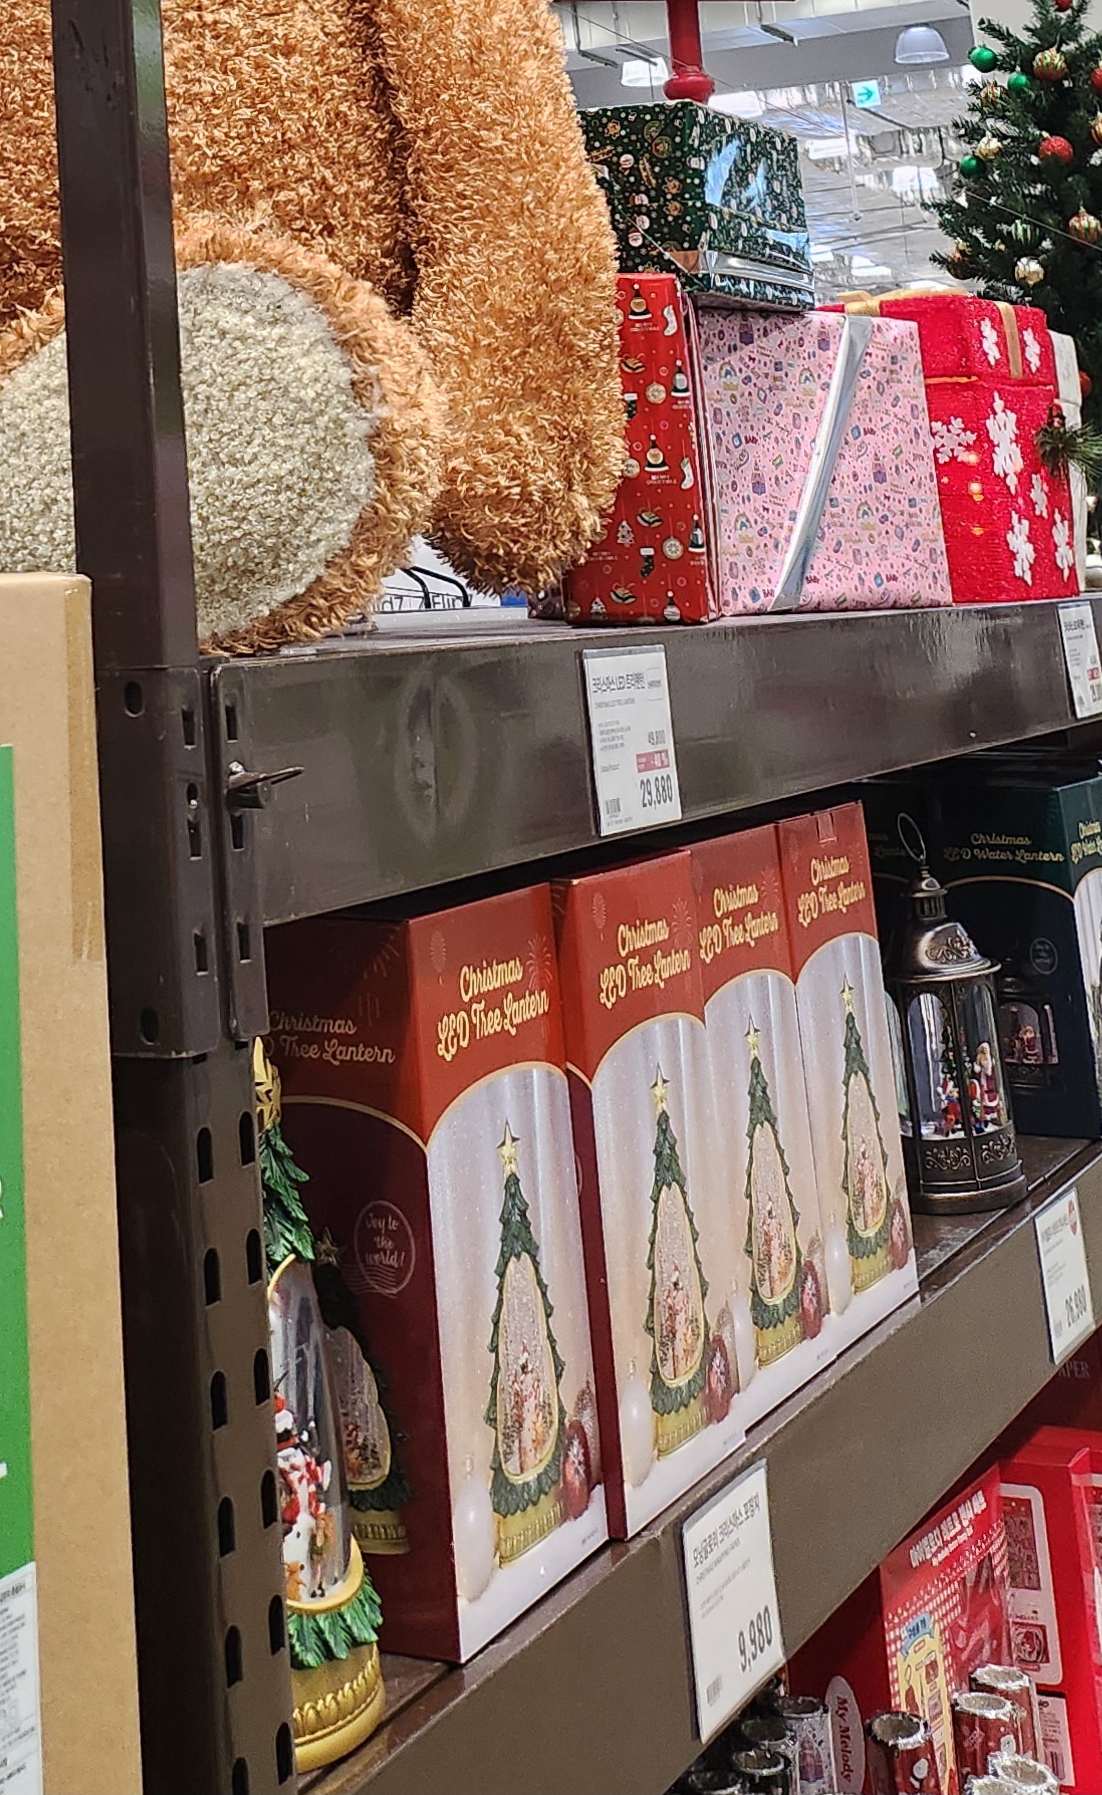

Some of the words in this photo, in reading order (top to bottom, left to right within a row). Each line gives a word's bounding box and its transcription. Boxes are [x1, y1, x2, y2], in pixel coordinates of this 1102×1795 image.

[639, 773, 674, 811] 29,880
[970, 832, 1033, 846] Christmas
[973, 848, 1014, 862] Water
[1014, 849, 1065, 864] Lantern
[809, 854, 851, 887] Christmas
[712, 882, 760, 919] Christmas
[616, 916, 671, 958] Christmas
[698, 922, 723, 965] LED
[722, 916, 747, 950] Tree
[745, 909, 780, 948] Lantern
[459, 955, 524, 1003] Christmas
[598, 961, 628, 1010] LED
[627, 952, 655, 992] Tree
[653, 946, 692, 990] Lantern
[268, 1009, 359, 1037] Christmas
[436, 1009, 470, 1062] LED
[471, 998, 503, 1041] Tree
[502, 988, 550, 1037] Lantern
[279, 1034, 322, 1060] Tree
[322, 1038, 396, 1066] Lantern
[736, 1604, 775, 1674] 9,980
[834, 1695, 850, 1724] My
[839, 1724, 855, 1784] Melody
